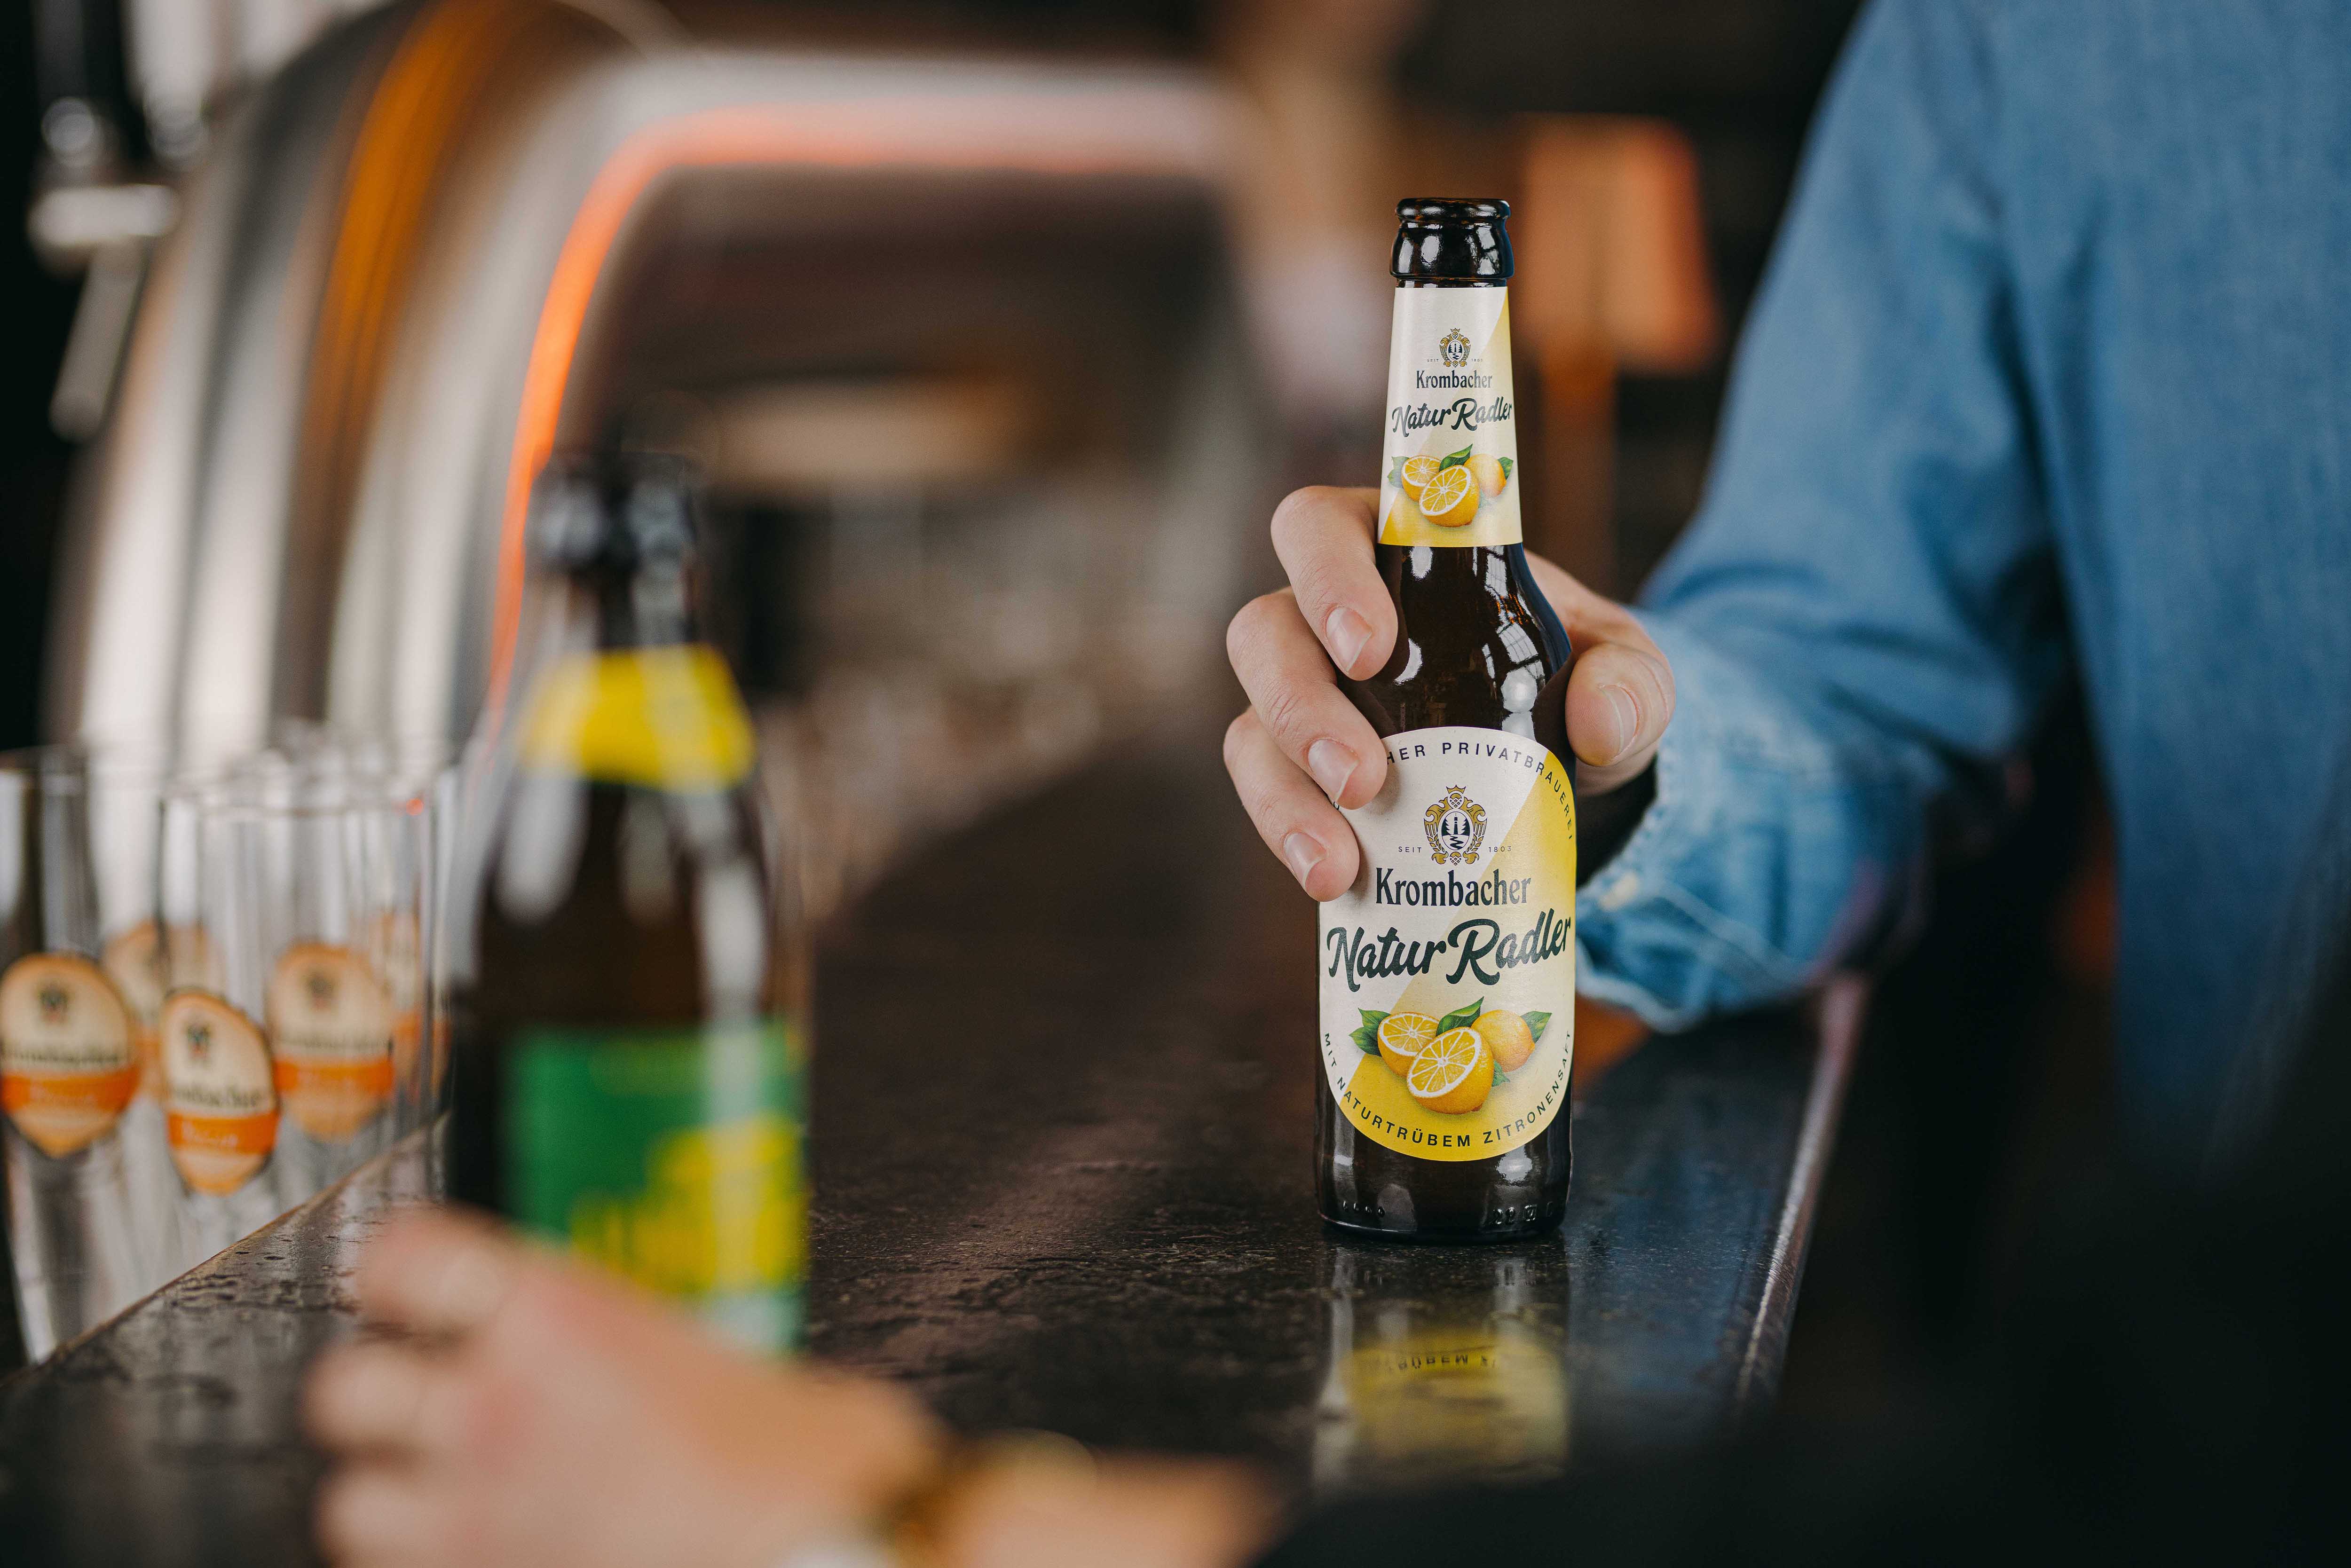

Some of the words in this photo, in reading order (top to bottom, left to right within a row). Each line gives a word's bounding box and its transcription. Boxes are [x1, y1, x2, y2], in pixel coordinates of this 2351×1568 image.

[1416, 370, 1492, 388] Krombacher
[1387, 745, 1426, 765] HER
[1442, 742, 1573, 839] PRIVATBRAUEREI
[1375, 867, 1531, 906] Krombacher
[1325, 1033, 1337, 1067] MIT
[1337, 1077, 1471, 1147] NATURTRÜBEM
[1483, 1030, 1570, 1144] ZITRONENSAFT
